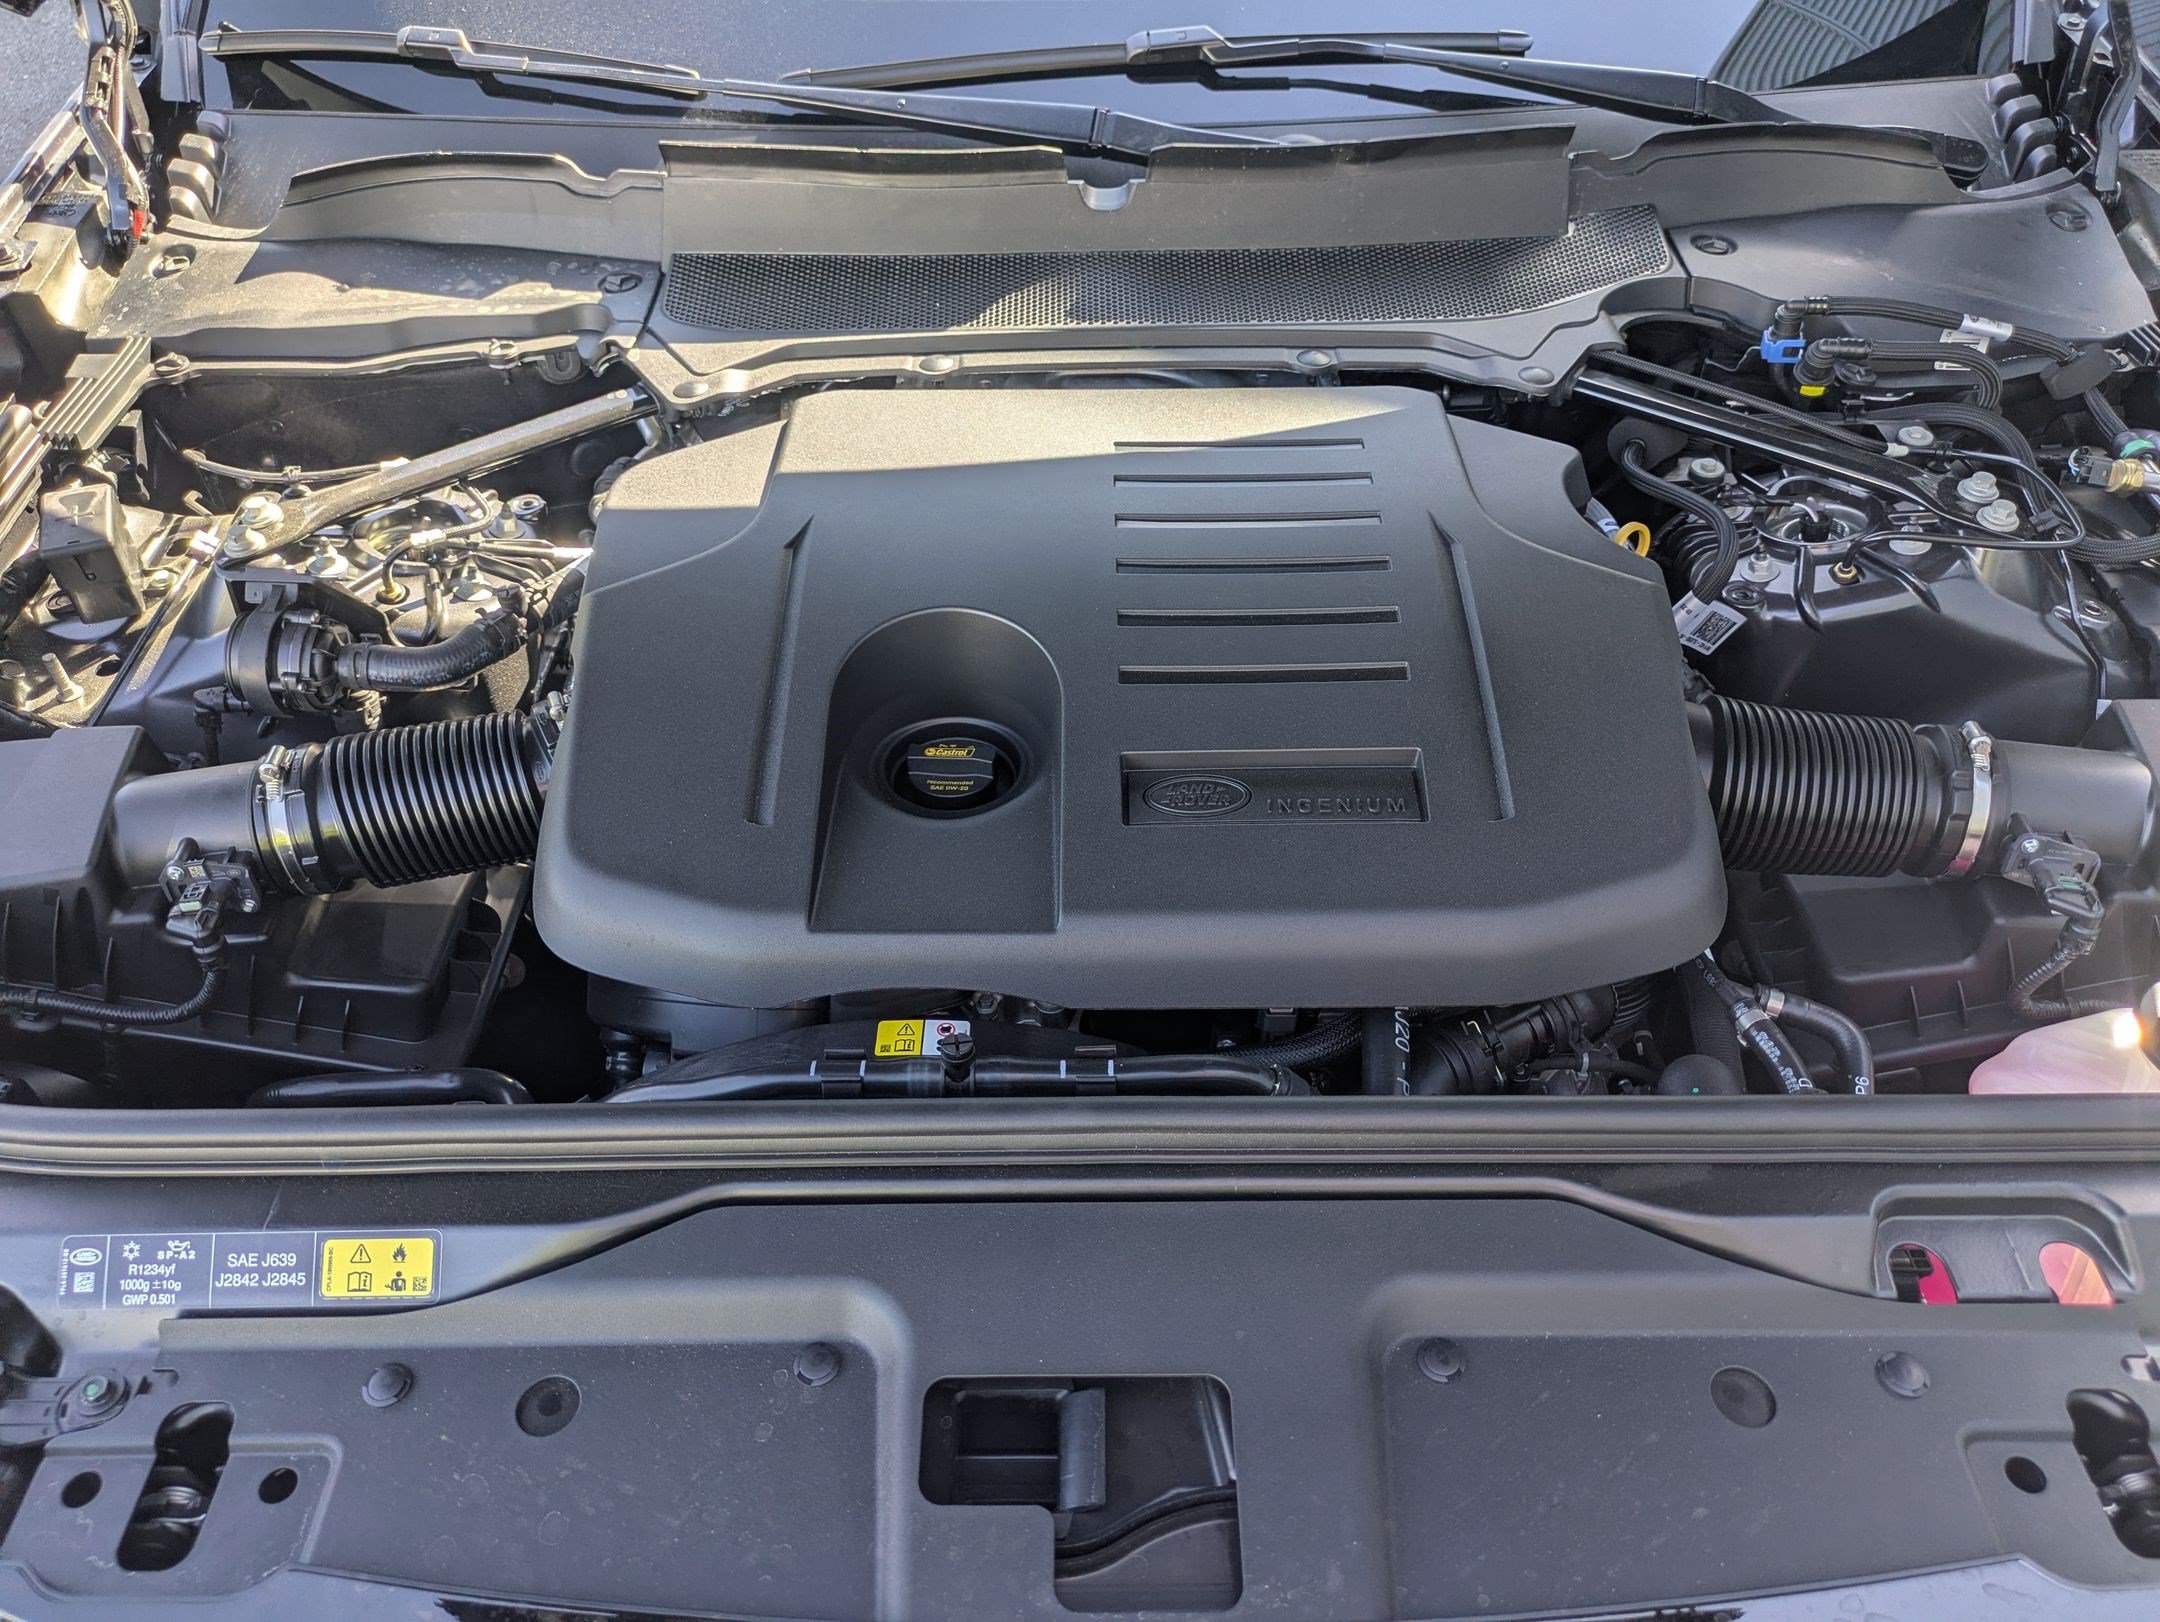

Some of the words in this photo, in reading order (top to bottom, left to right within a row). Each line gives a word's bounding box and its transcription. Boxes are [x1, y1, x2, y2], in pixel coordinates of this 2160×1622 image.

[1166, 783, 1215, 795] LAND
[1170, 794, 1230, 807] ROVER
[1265, 797, 1407, 814] INGENIUM
[157, 1250, 196, 1260] SP-A2
[227, 1253, 259, 1267] SAE
[261, 1252, 297, 1267] J639
[128, 1263, 176, 1277] R1234yf
[119, 1279, 150, 1292] 1000g
[152, 1280, 182, 1291] ±10g
[215, 1273, 259, 1287] J2842
[262, 1272, 306, 1286] J2845
[122, 1294, 148, 1306] GWP
[149, 1293, 176, 1305] 0.501
